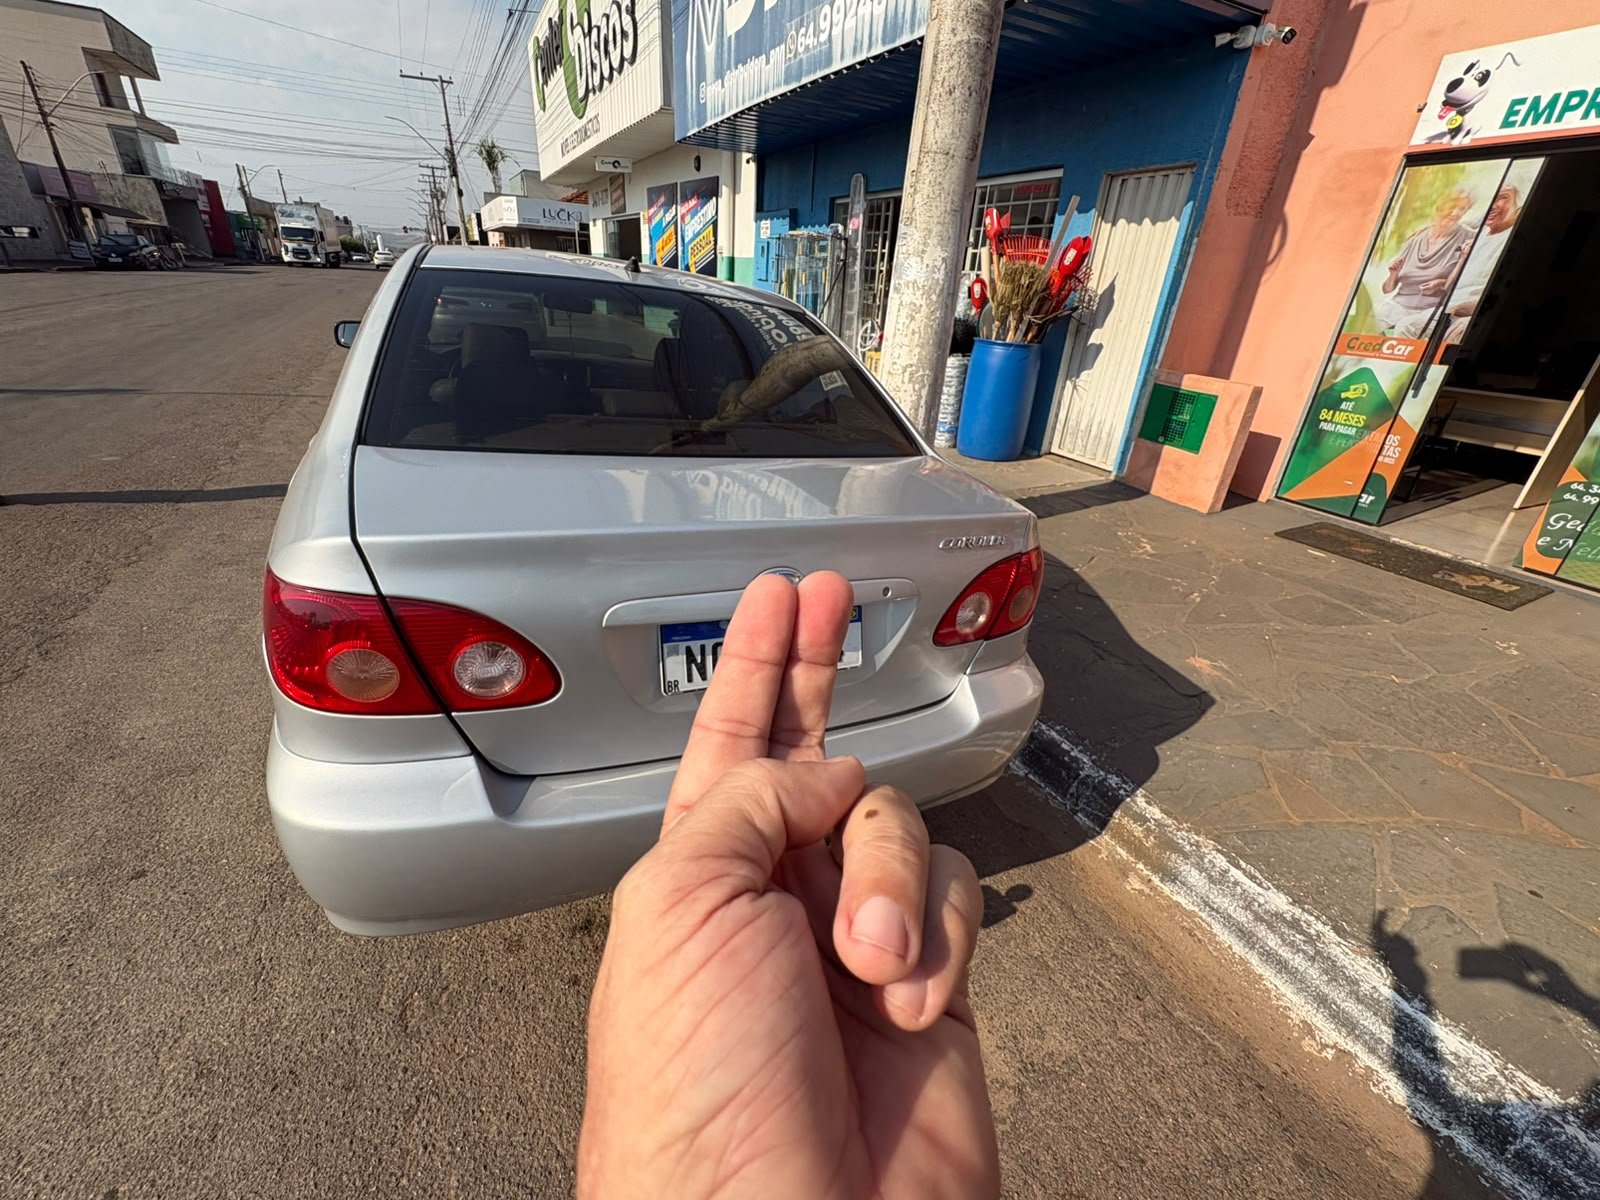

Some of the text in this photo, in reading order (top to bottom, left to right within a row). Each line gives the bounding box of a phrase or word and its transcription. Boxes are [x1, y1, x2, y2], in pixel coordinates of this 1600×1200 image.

[1346, 336, 1415, 356] CredCar
[1340, 400, 1355, 411] ATÉ
[1319, 408, 1366, 428] 84 MESES
[1319, 421, 1357, 436] PARA PAGAR
[667, 680, 680, 693] BR
